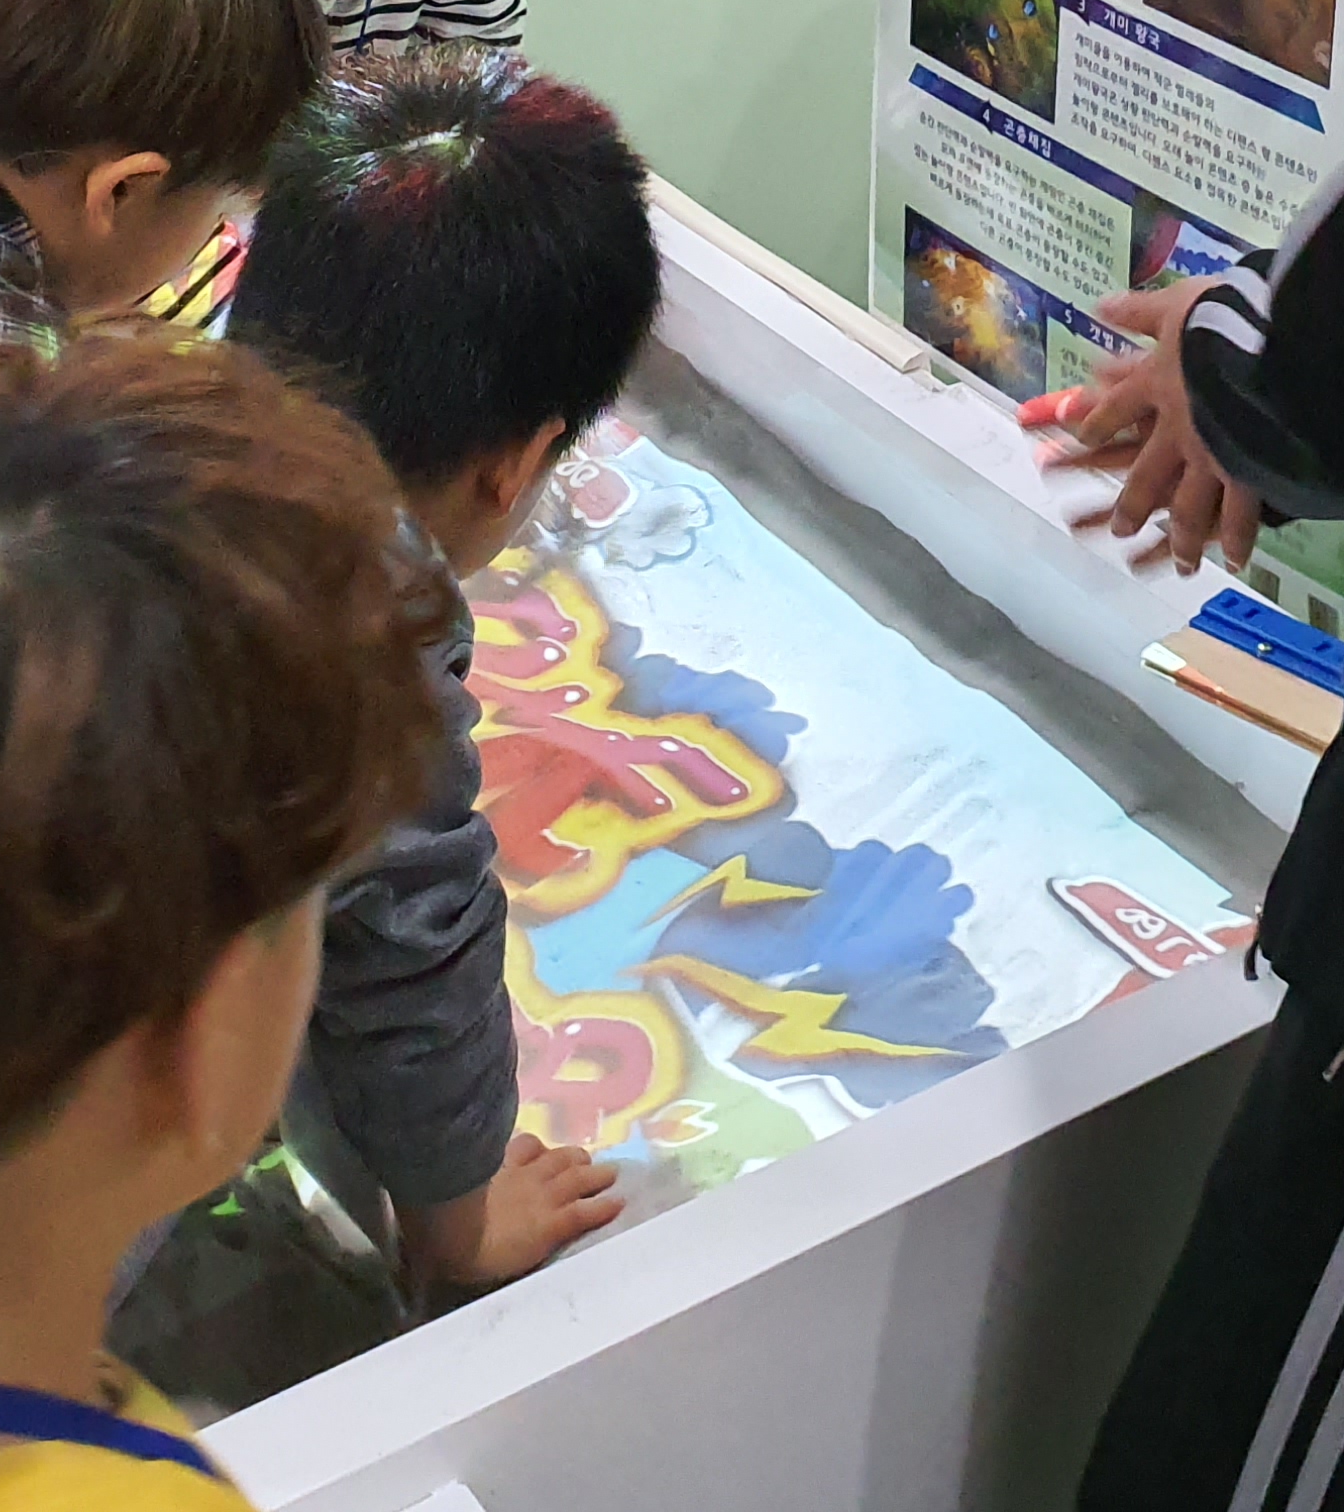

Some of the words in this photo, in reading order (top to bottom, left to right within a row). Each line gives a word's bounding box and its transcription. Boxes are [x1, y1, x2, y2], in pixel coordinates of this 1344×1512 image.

[1104, 8, 1128, 36] 개미
[1134, 24, 1160, 51] 왕국
[983, 108, 989, 123] 4
[1004, 119, 1052, 159] 곤충채집
[1065, 309, 1072, 324] 5
